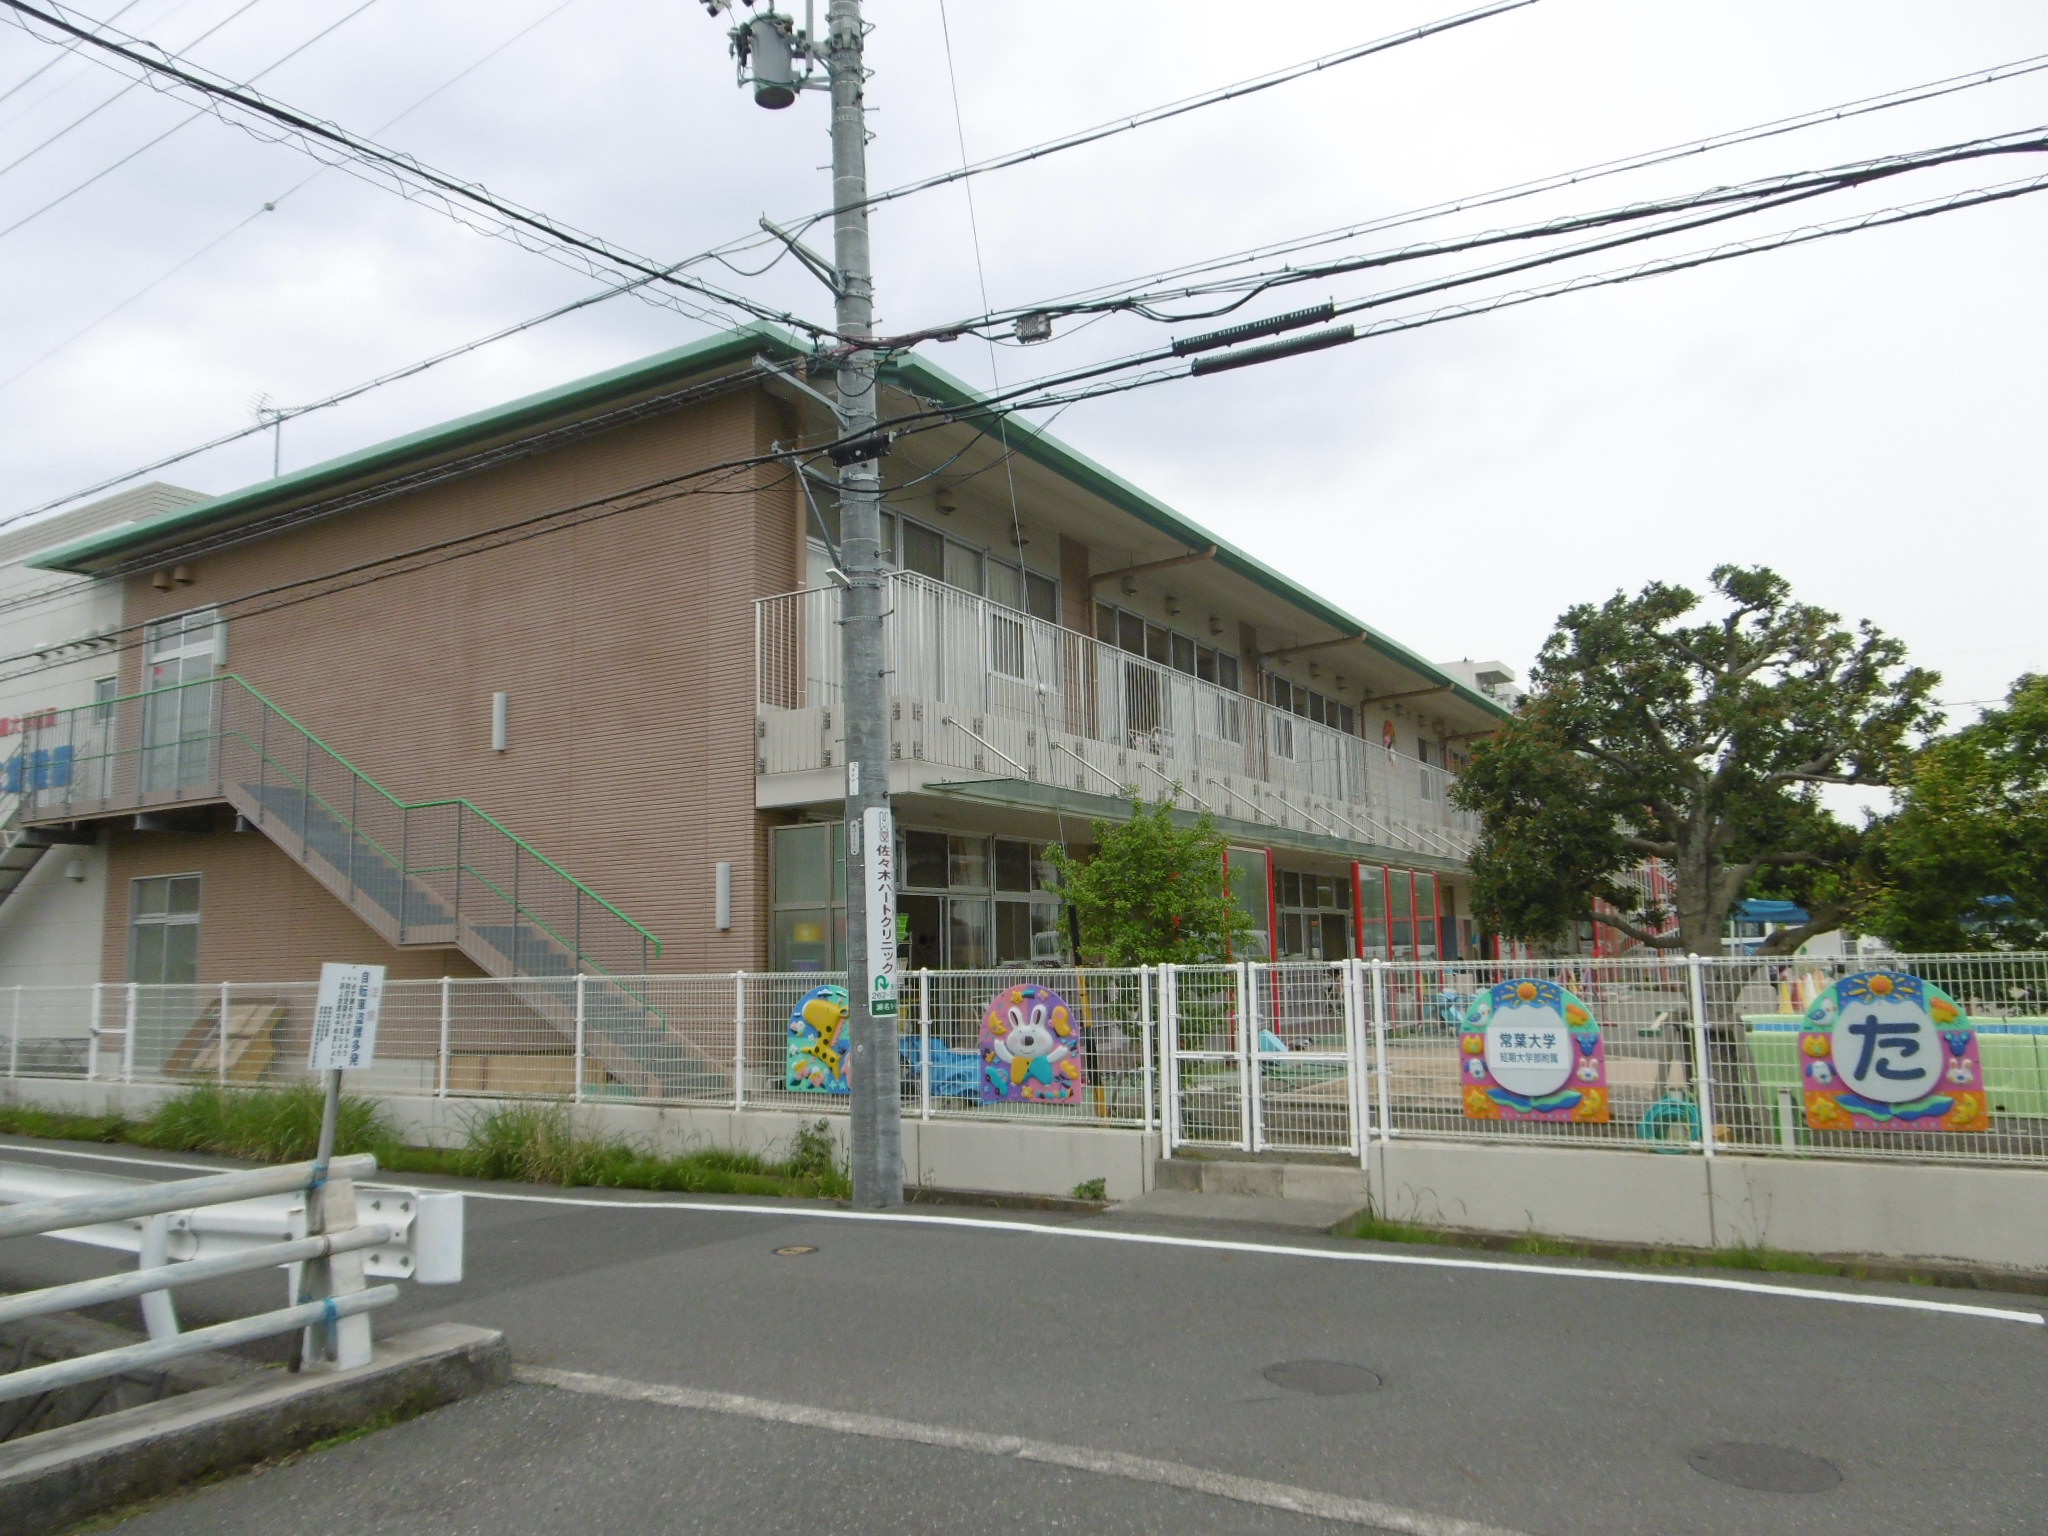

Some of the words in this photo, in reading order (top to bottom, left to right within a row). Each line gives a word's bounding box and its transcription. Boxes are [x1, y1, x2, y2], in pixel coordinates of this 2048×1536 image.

[876, 845, 893, 974] 佐々木ハートクリニック
[1499, 1032, 1557, 1049] 常葉大学
[1500, 1052, 1559, 1064] 短期大学部附属
[1848, 1014, 1926, 1081] た
